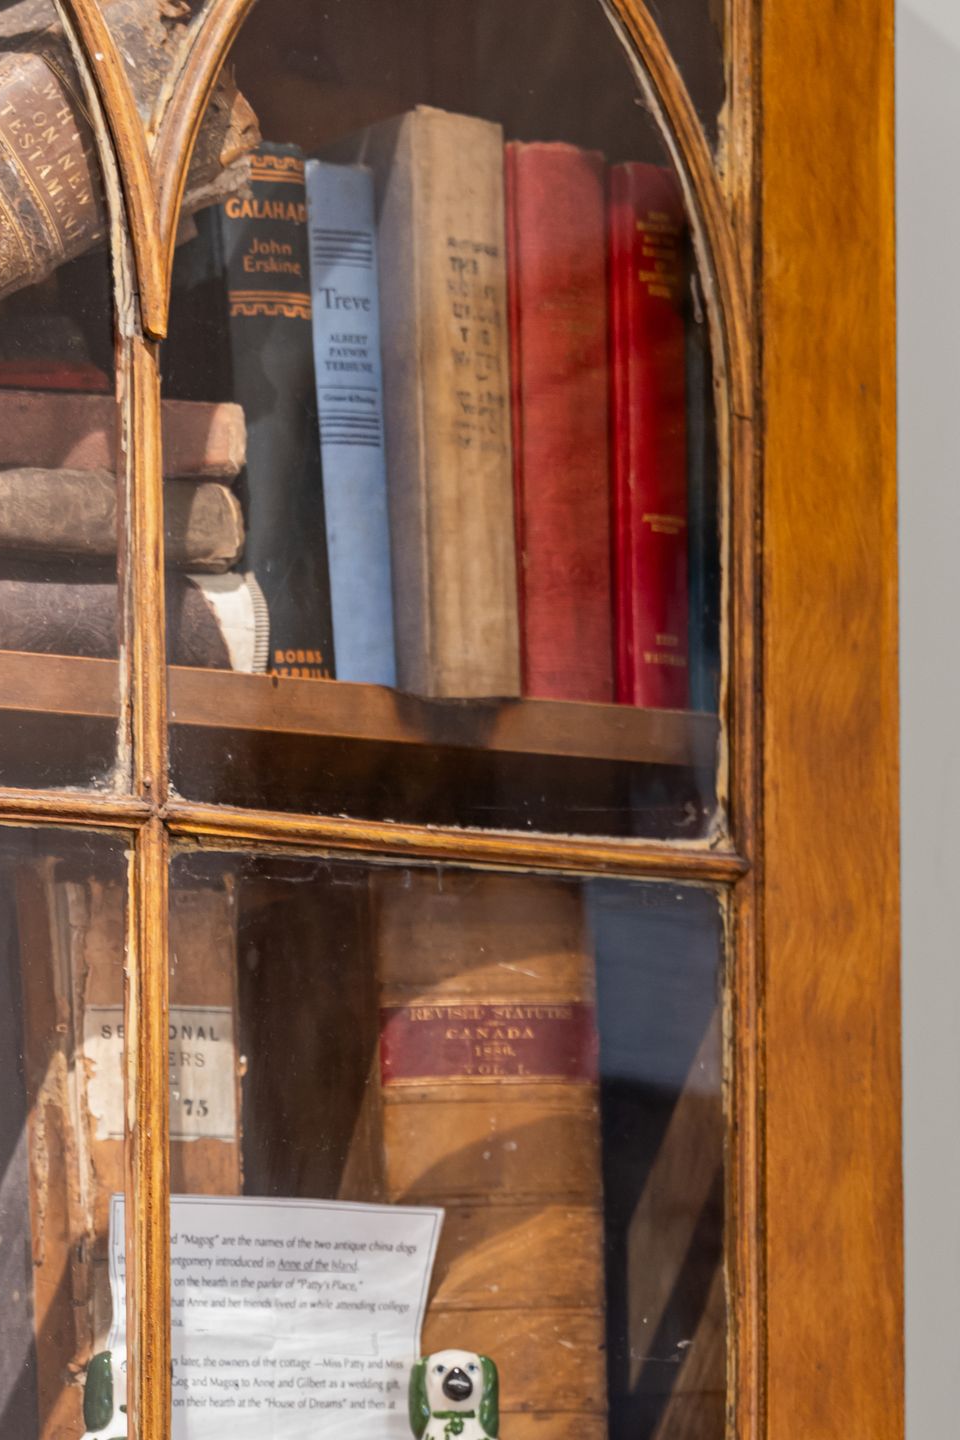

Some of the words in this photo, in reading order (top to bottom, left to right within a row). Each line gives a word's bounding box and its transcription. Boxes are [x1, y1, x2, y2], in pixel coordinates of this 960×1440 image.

[248, 238, 293, 254] John
[243, 255, 303, 277] Erskine
[319, 286, 372, 312] Treve
[274, 649, 323, 664] BOBBS
[494, 1007, 574, 1021] STATUTES
[445, 1028, 536, 1040] CANADA
[222, 1237, 236, 1246] are
[238, 1235, 252, 1246] the
[254, 1238, 284, 1248] names
[286, 1237, 296, 1248] of
[298, 1238, 311, 1248] the
[314, 1240, 331, 1249] two
[333, 1240, 367, 1253] antique
[369, 1240, 393, 1252] china
[395, 1242, 417, 1256] dogs
[215, 1257, 264, 1268] introduced
[266, 1258, 276, 1268] in
[278, 1259, 303, 1270] Anne
[304, 1259, 314, 1270] of
[315, 1260, 329, 1270] the
[174, 1279, 186, 1287] on
[187, 1276, 200, 1287] the
[201, 1277, 228, 1287] hearth
[241, 1277, 254, 1288] the
[257, 1278, 283, 1290] parlor
[285, 1277, 295, 1288] of
[211, 1298, 226, 1307] and
[228, 1298, 241, 1307] her
[203, 1355, 217, 1367] the
[218, 1358, 250, 1367] owners
[263, 1356, 276, 1367] the
[279, 1358, 311, 1370] cottage
[278, 1378, 294, 1388] and
[173, 1399, 185, 1407] on
[187, 1397, 207, 1407] their
[209, 1398, 236, 1408] hearth
[247, 1398, 262, 1408] the
[350, 1399, 366, 1409] and
